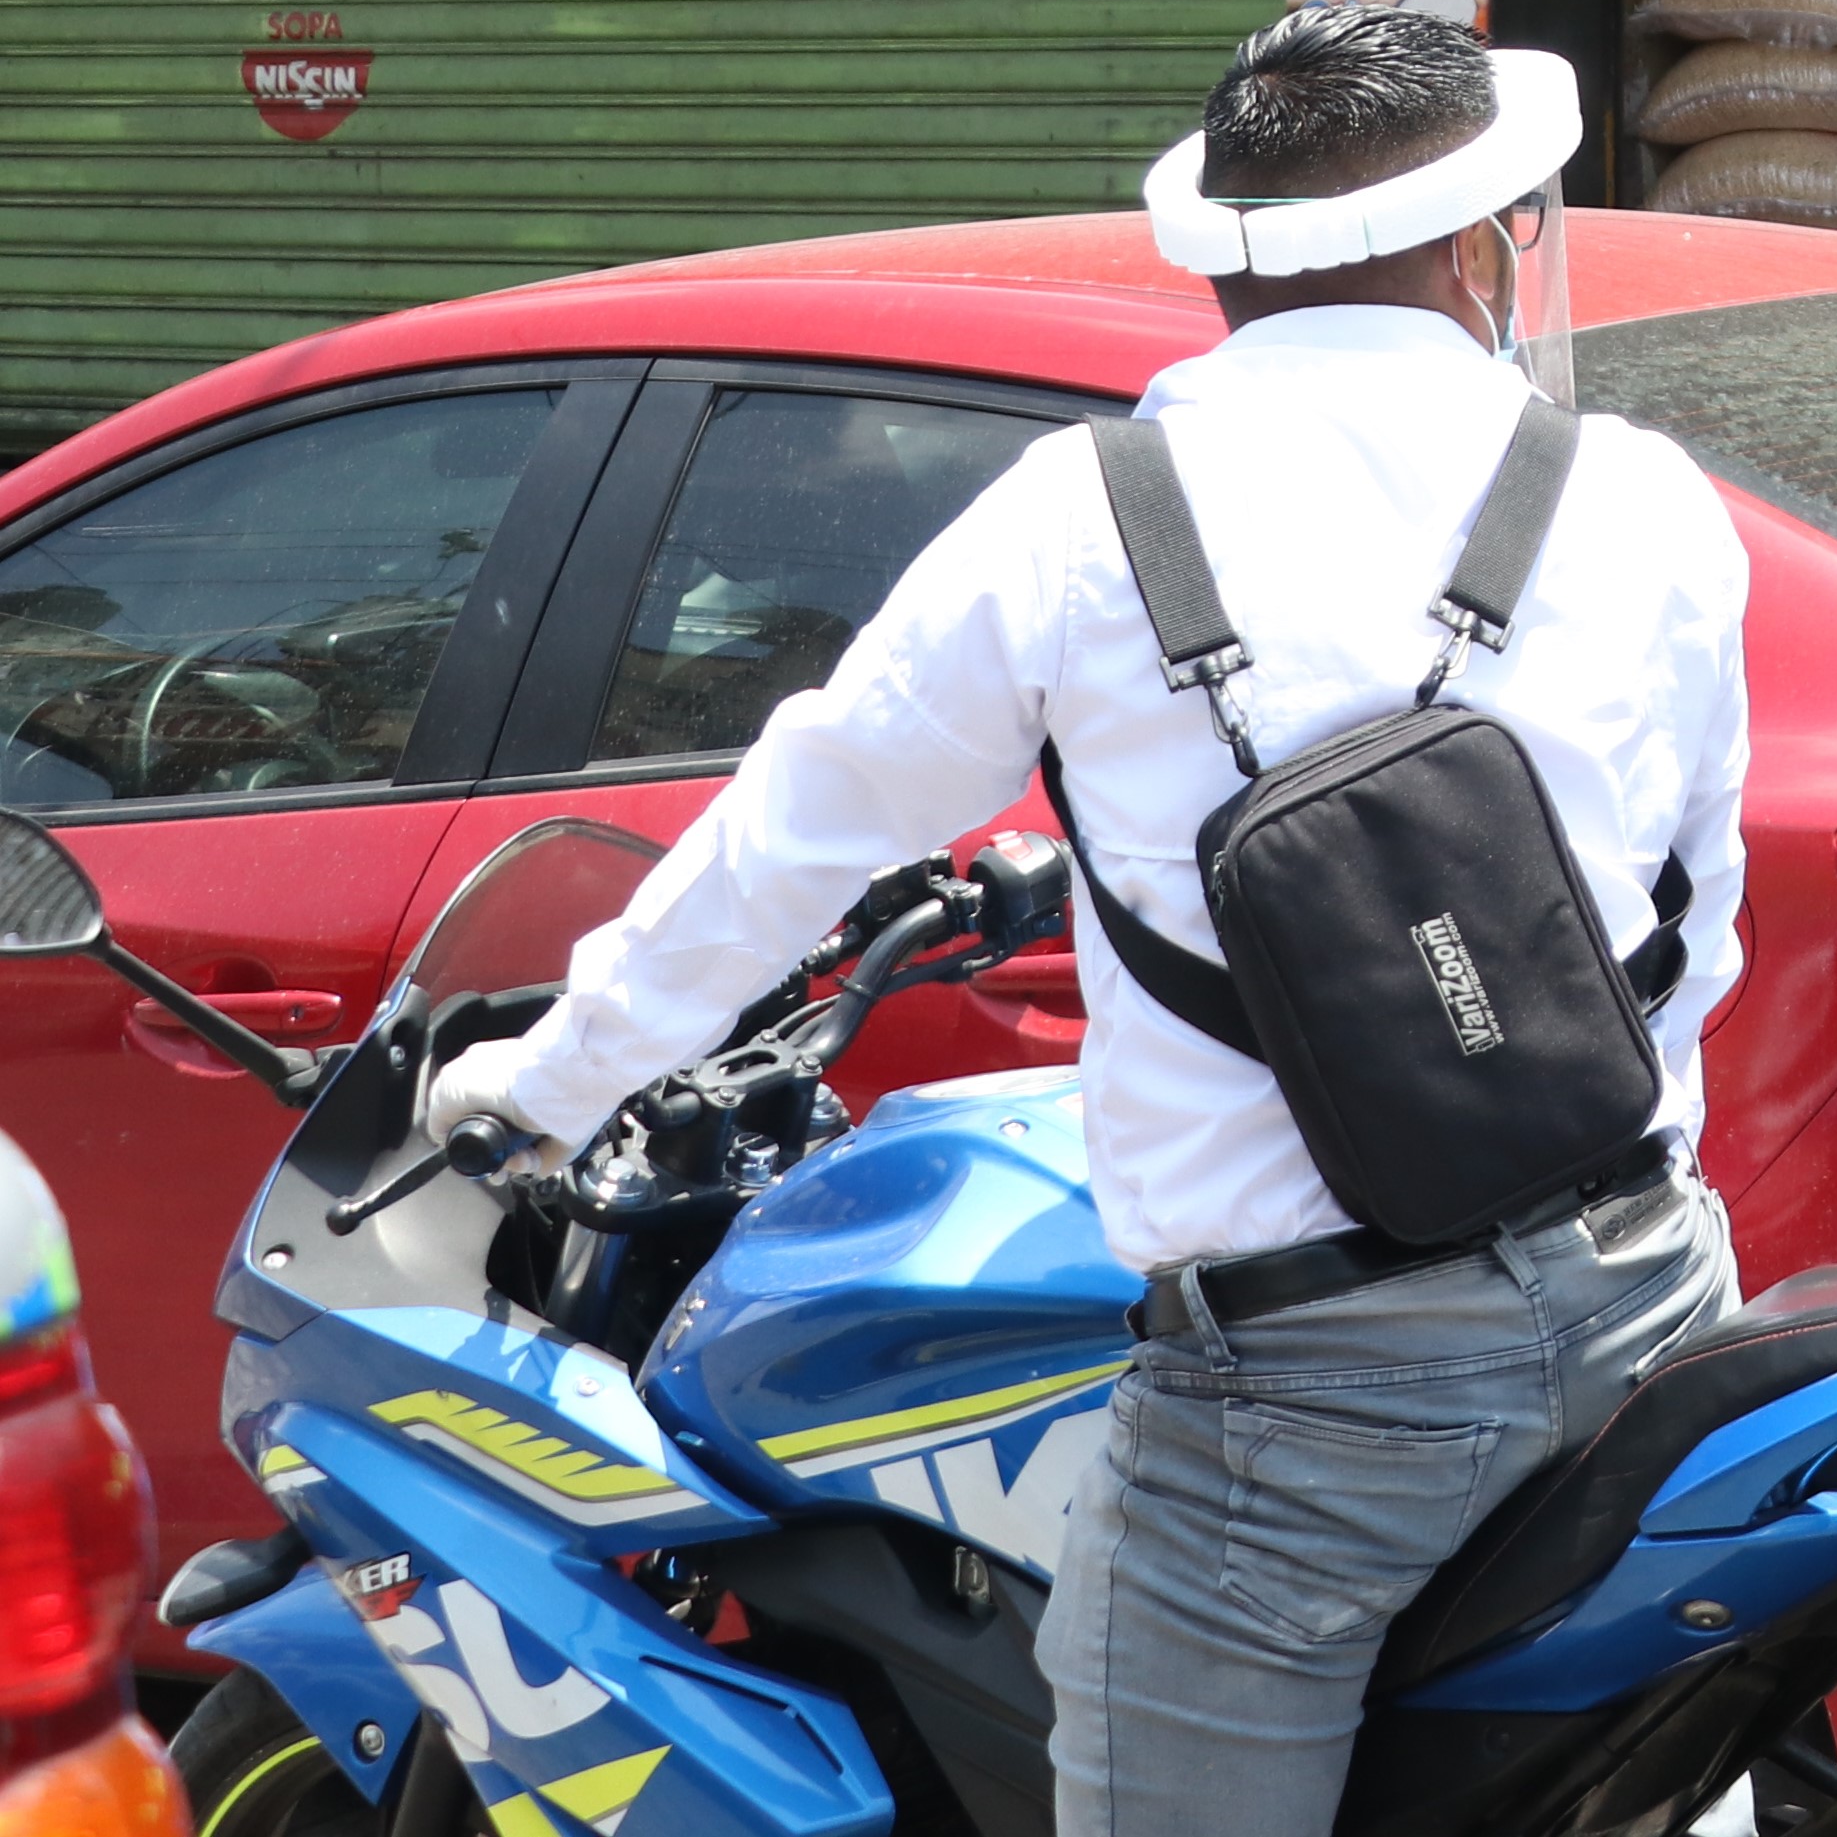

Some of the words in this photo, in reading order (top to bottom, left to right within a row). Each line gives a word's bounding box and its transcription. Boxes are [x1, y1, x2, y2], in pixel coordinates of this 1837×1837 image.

[266, 10, 344, 42] SOPA
[1421, 916, 1492, 1056] Varizoom
[1441, 911, 1506, 1044] www.varizoom.com
